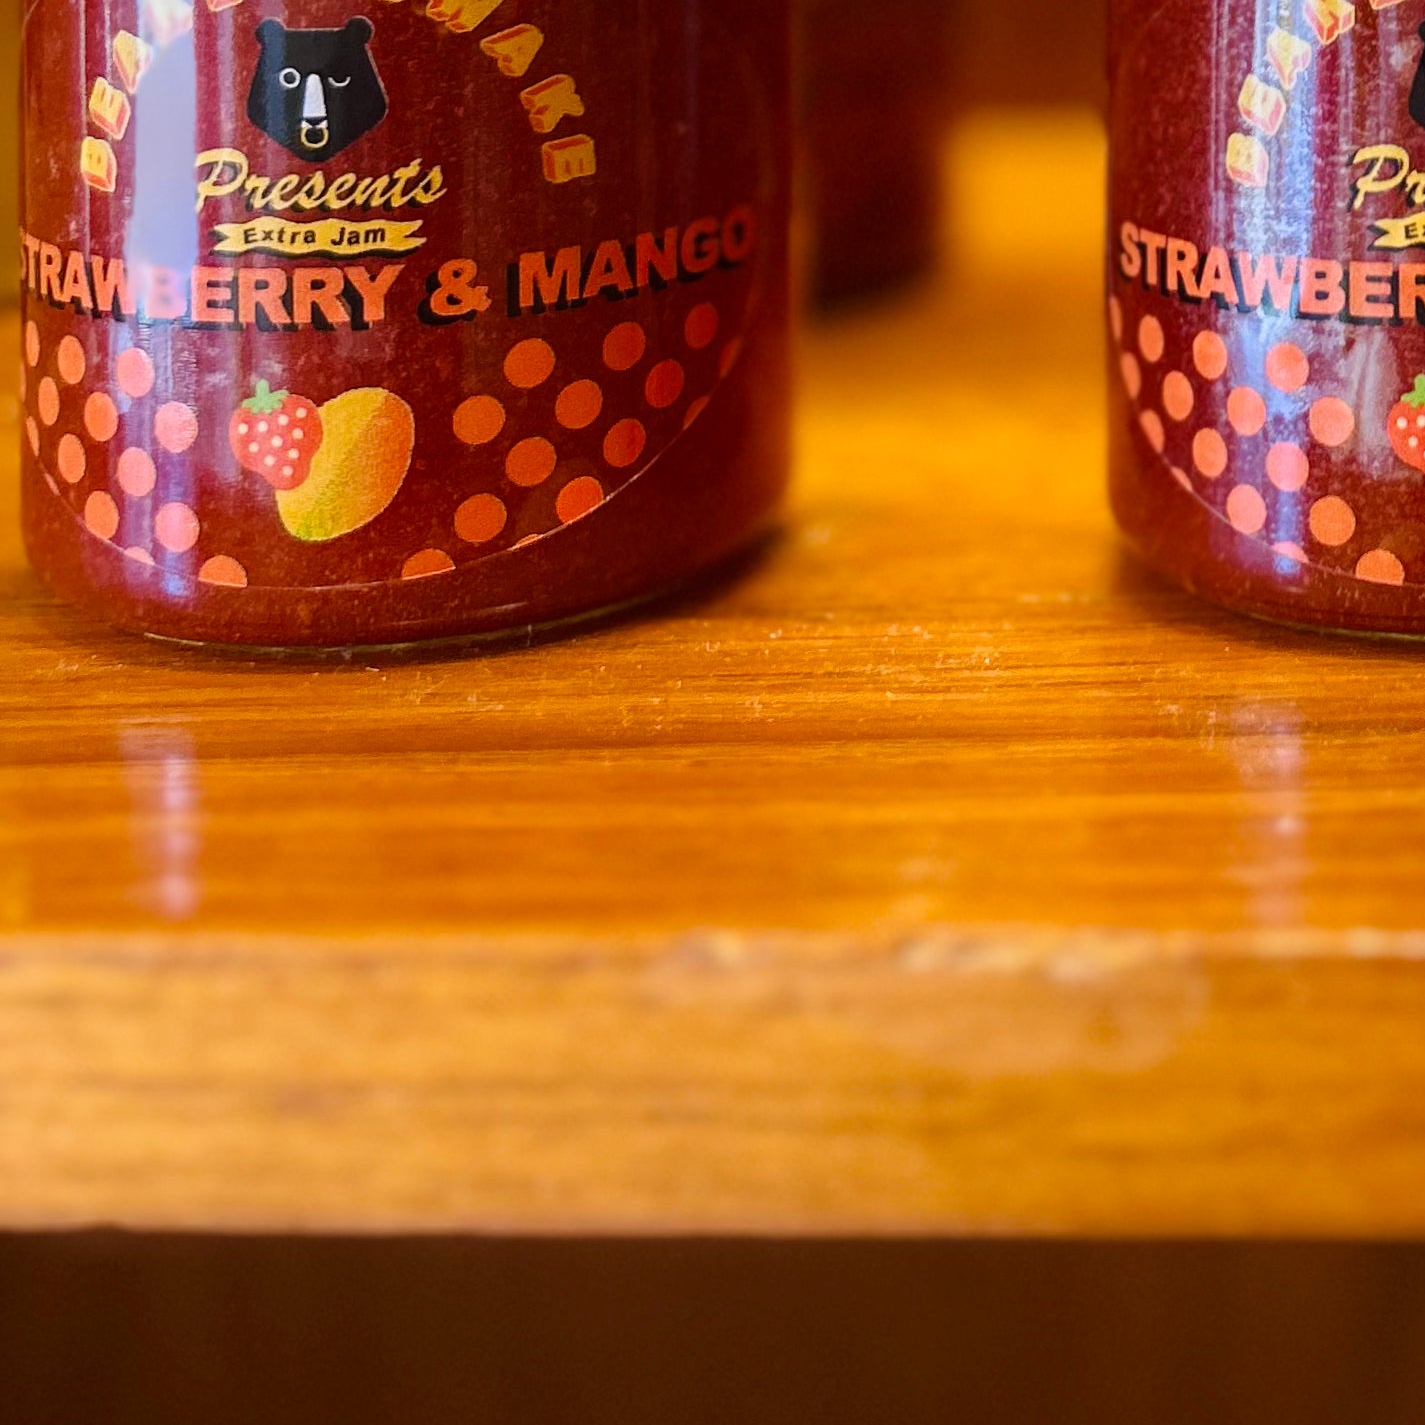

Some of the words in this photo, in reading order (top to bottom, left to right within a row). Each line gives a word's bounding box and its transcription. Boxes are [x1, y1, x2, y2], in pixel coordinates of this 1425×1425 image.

[195, 147, 447, 213] Presents
[242, 224, 317, 247] Extra
[330, 224, 387, 248] Jam
[422, 258, 492, 322] &
[512, 205, 755, 315] MANGO
